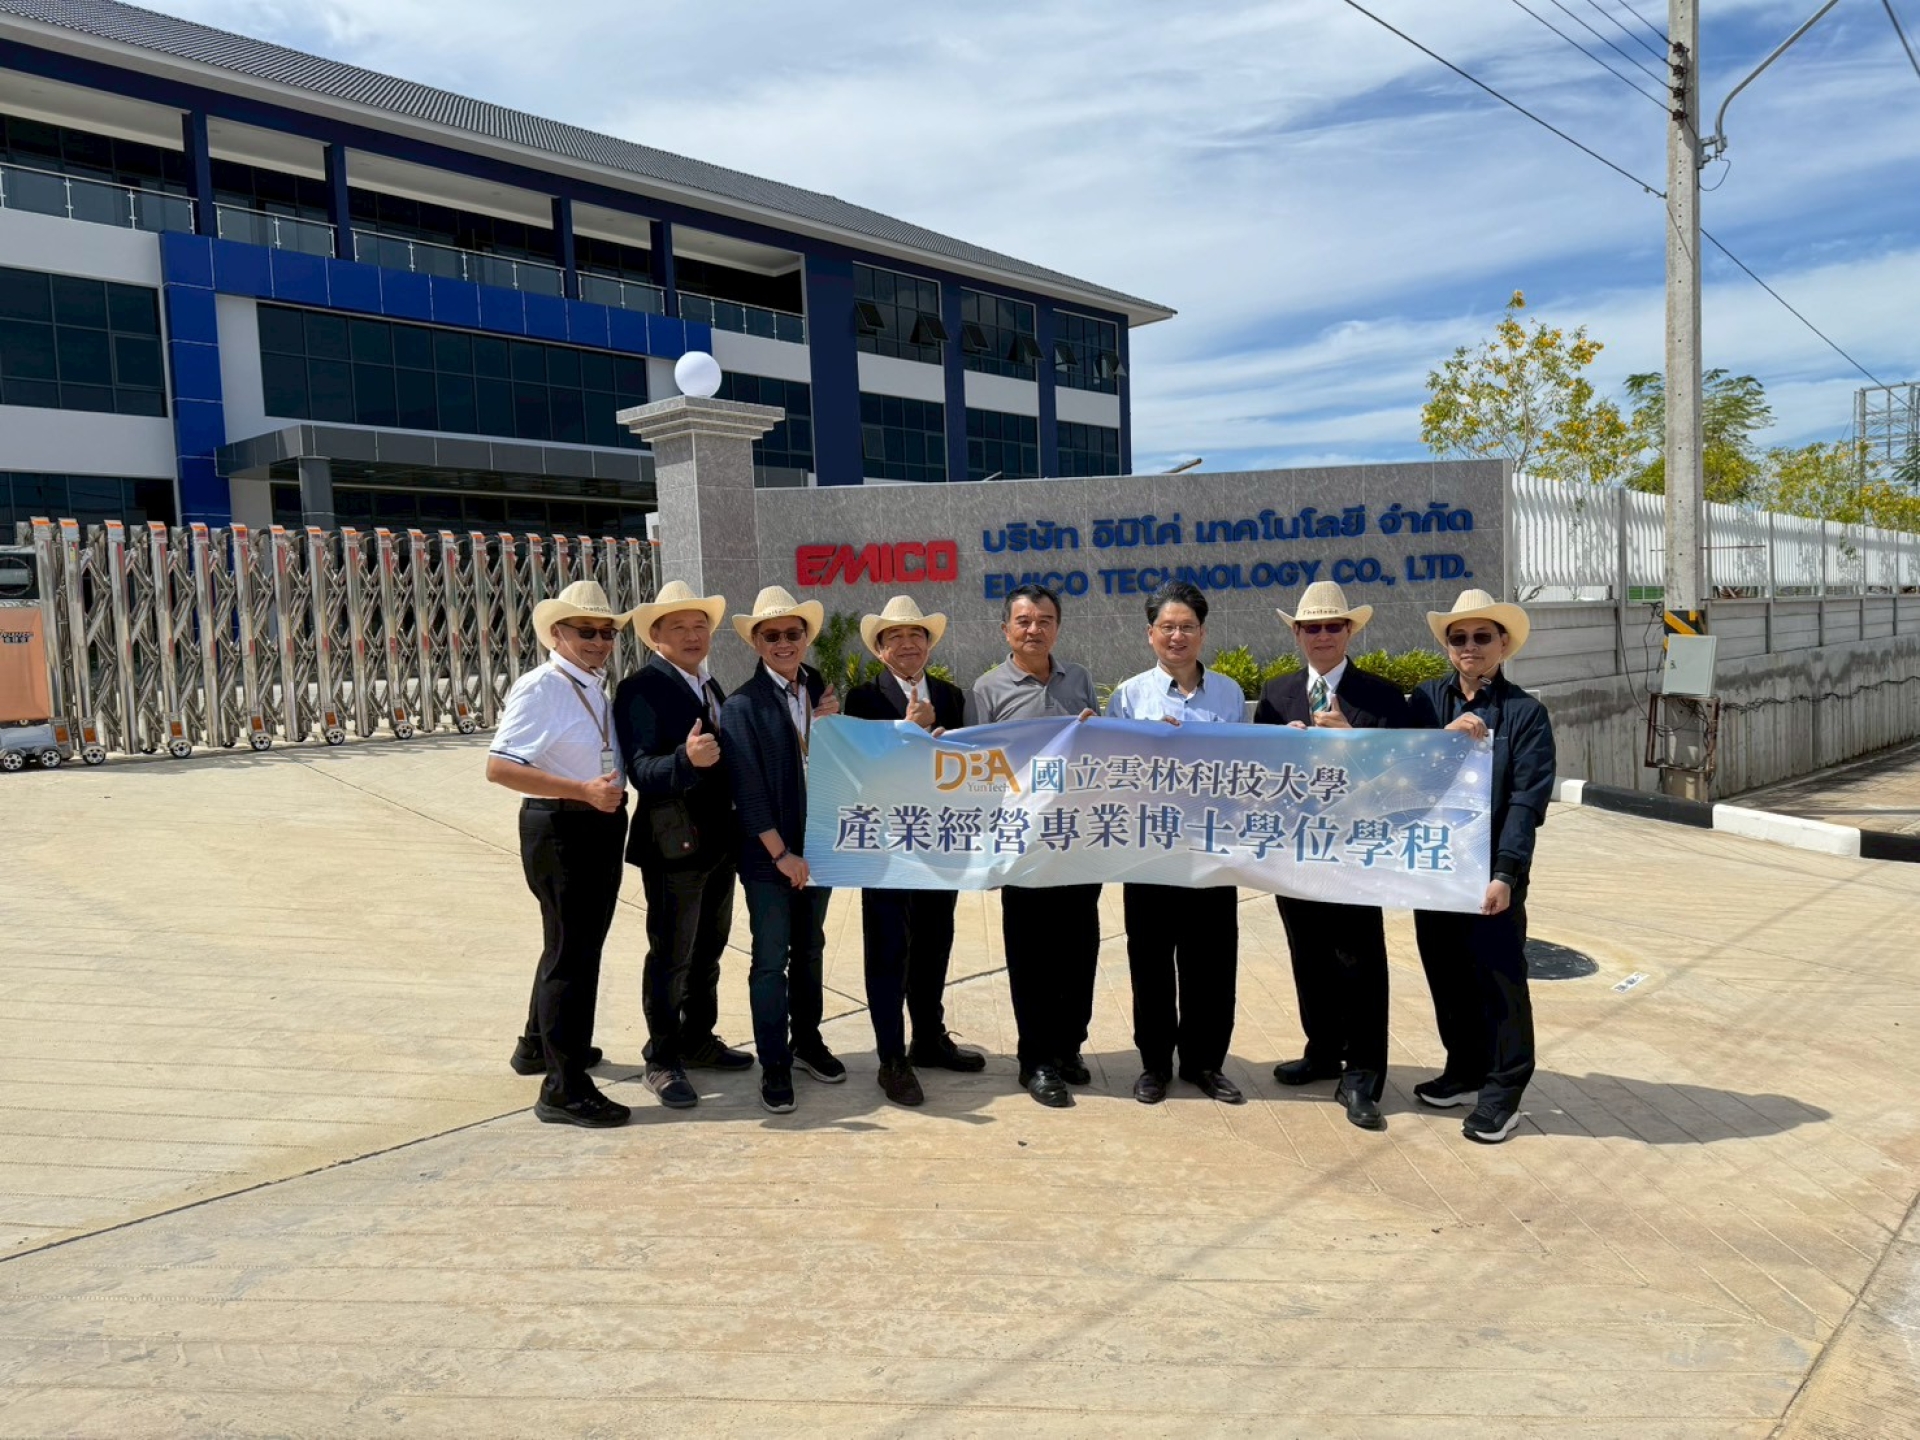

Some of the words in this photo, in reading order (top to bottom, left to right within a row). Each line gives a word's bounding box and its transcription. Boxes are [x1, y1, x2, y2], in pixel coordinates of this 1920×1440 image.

[983, 520, 1079, 552] บริษัท
[1195, 504, 1366, 543] เทคโนโลยี
[1378, 501, 1473, 534] จำกัด
[795, 540, 958, 586] EMICO
[1098, 560, 1322, 595] TECHNOLOGY
[1332, 558, 1396, 586] CO.,
[1406, 554, 1473, 582] LTD.
[935, 748, 1021, 792] DBA
[967, 781, 1011, 793] YunTech
[1031, 756, 1347, 801] 國立雲林科技大學
[835, 804, 1455, 871] 產業經營專業博士學位學程
